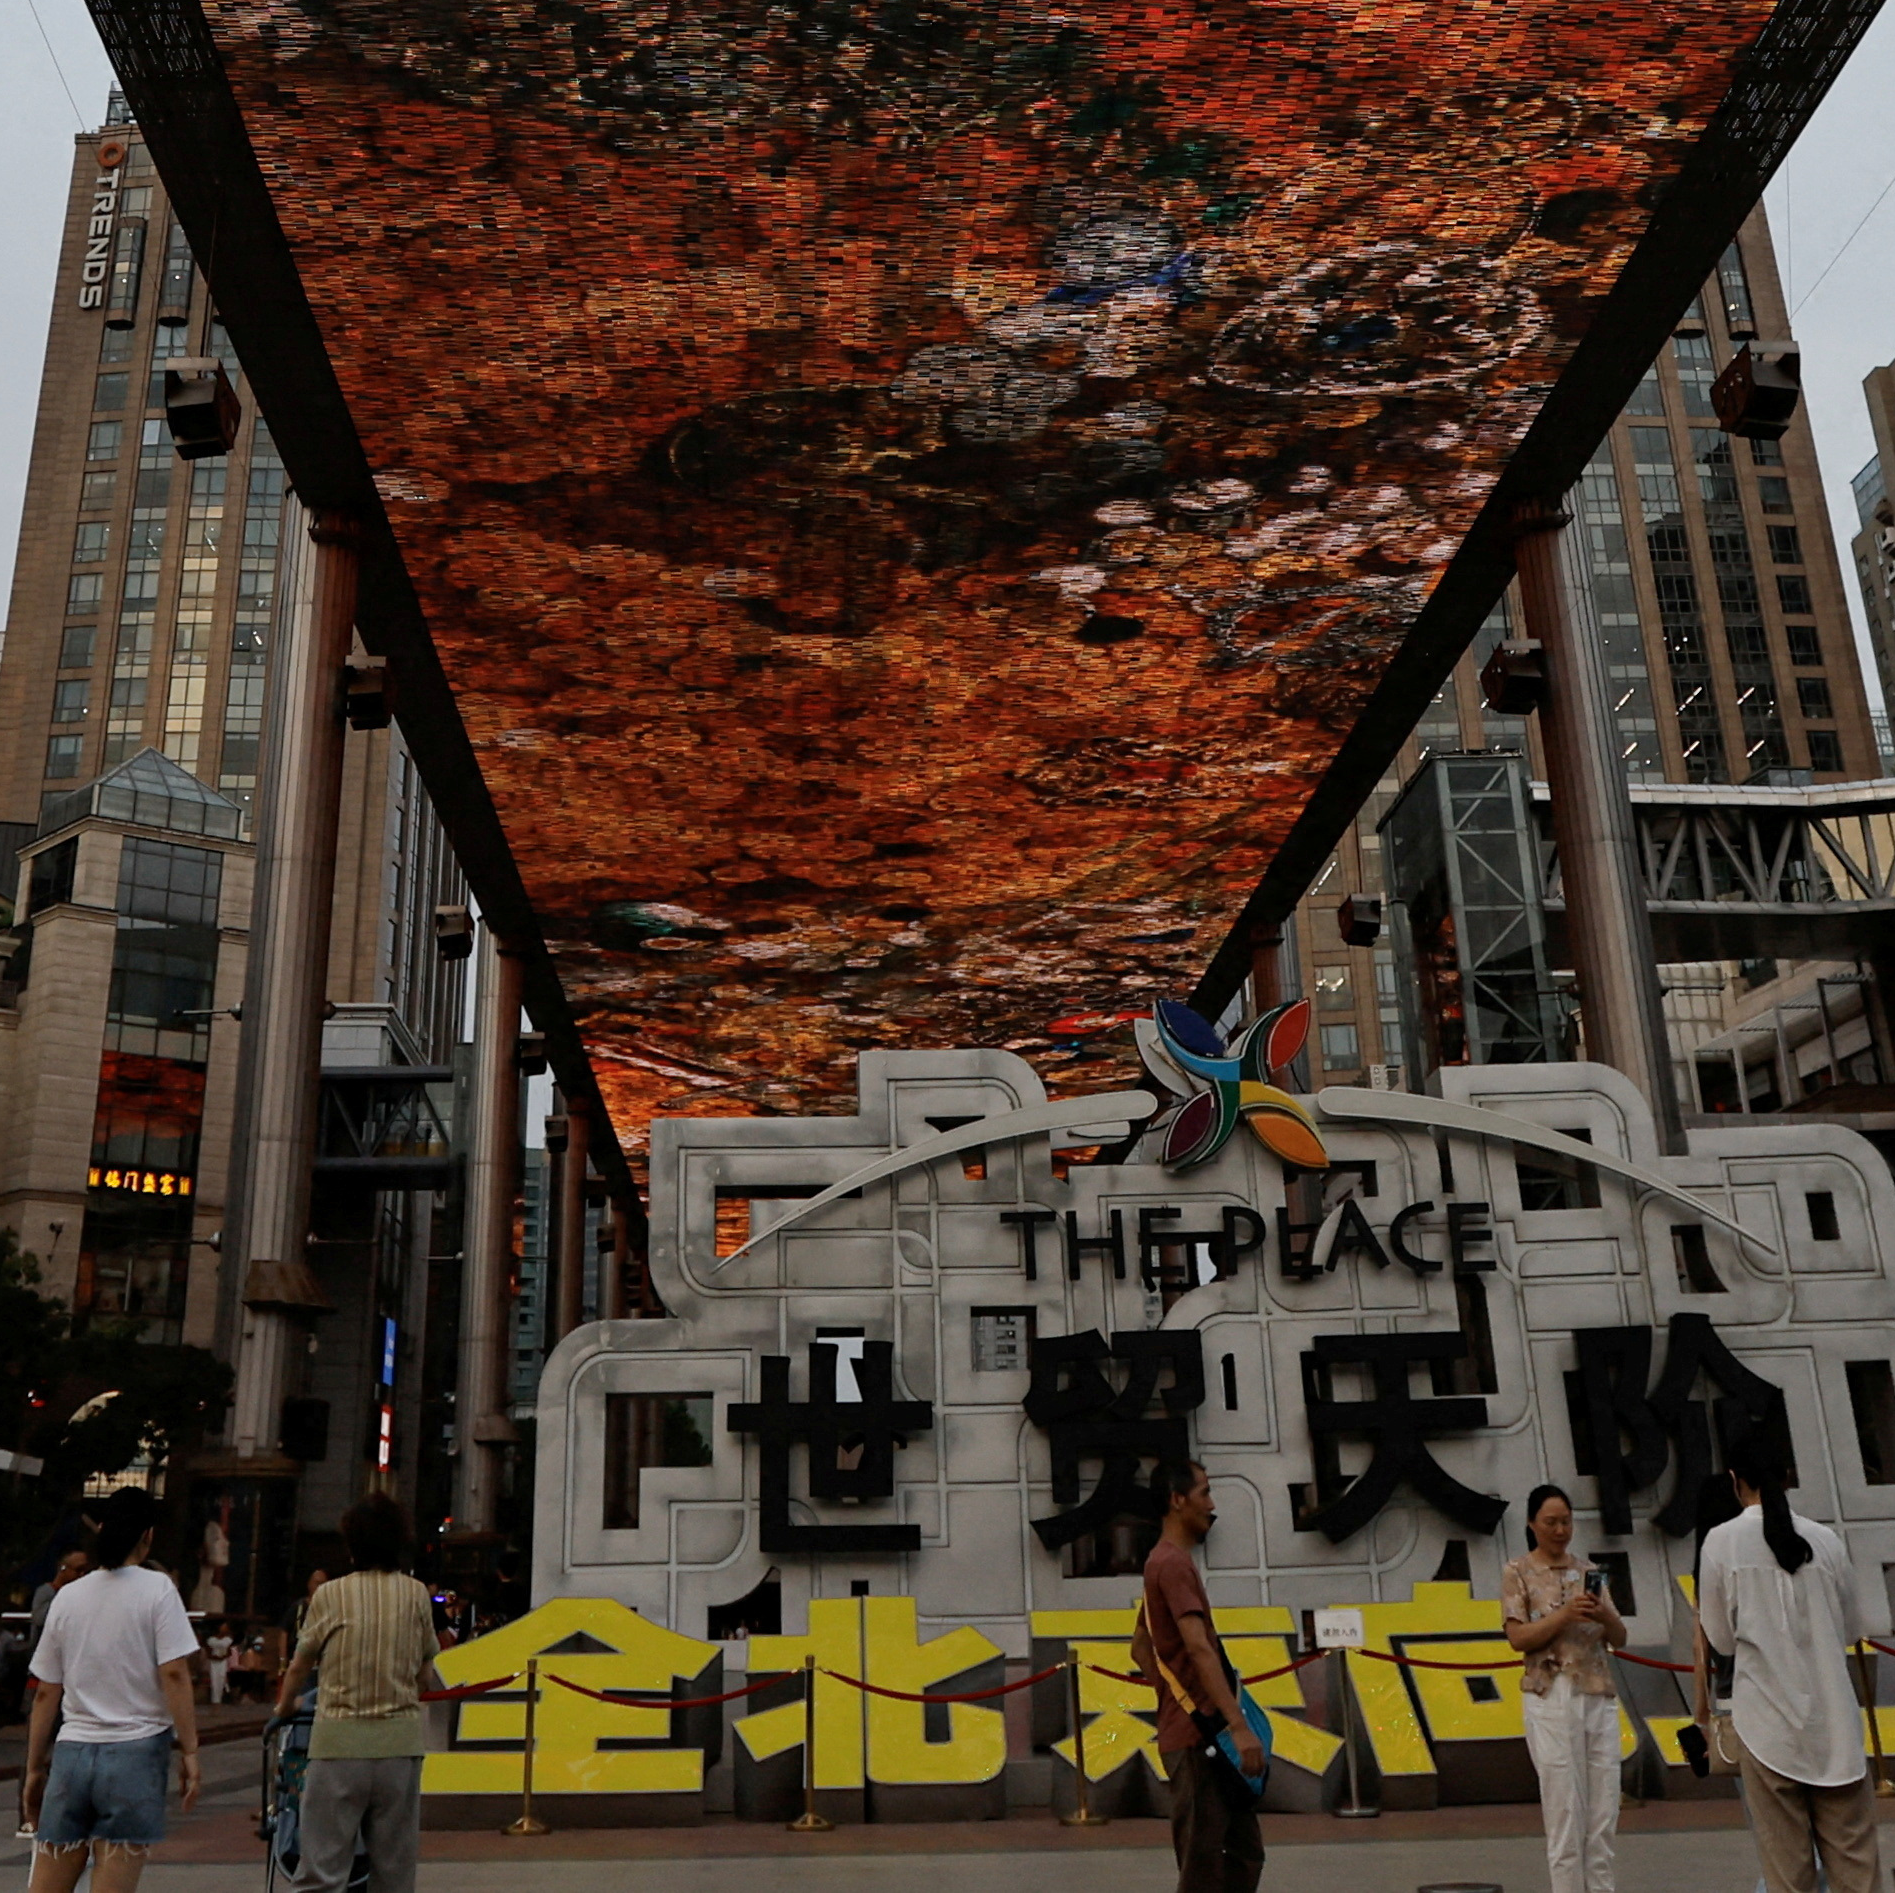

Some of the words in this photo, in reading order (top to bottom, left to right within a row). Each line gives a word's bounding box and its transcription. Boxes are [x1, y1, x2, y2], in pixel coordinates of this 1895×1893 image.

[79, 168, 120, 310] TRENDS
[1000, 1206, 1183, 1282] THE
[1221, 1199, 1497, 1278] PLACE
[727, 1311, 1786, 1551] 世贸天阶
